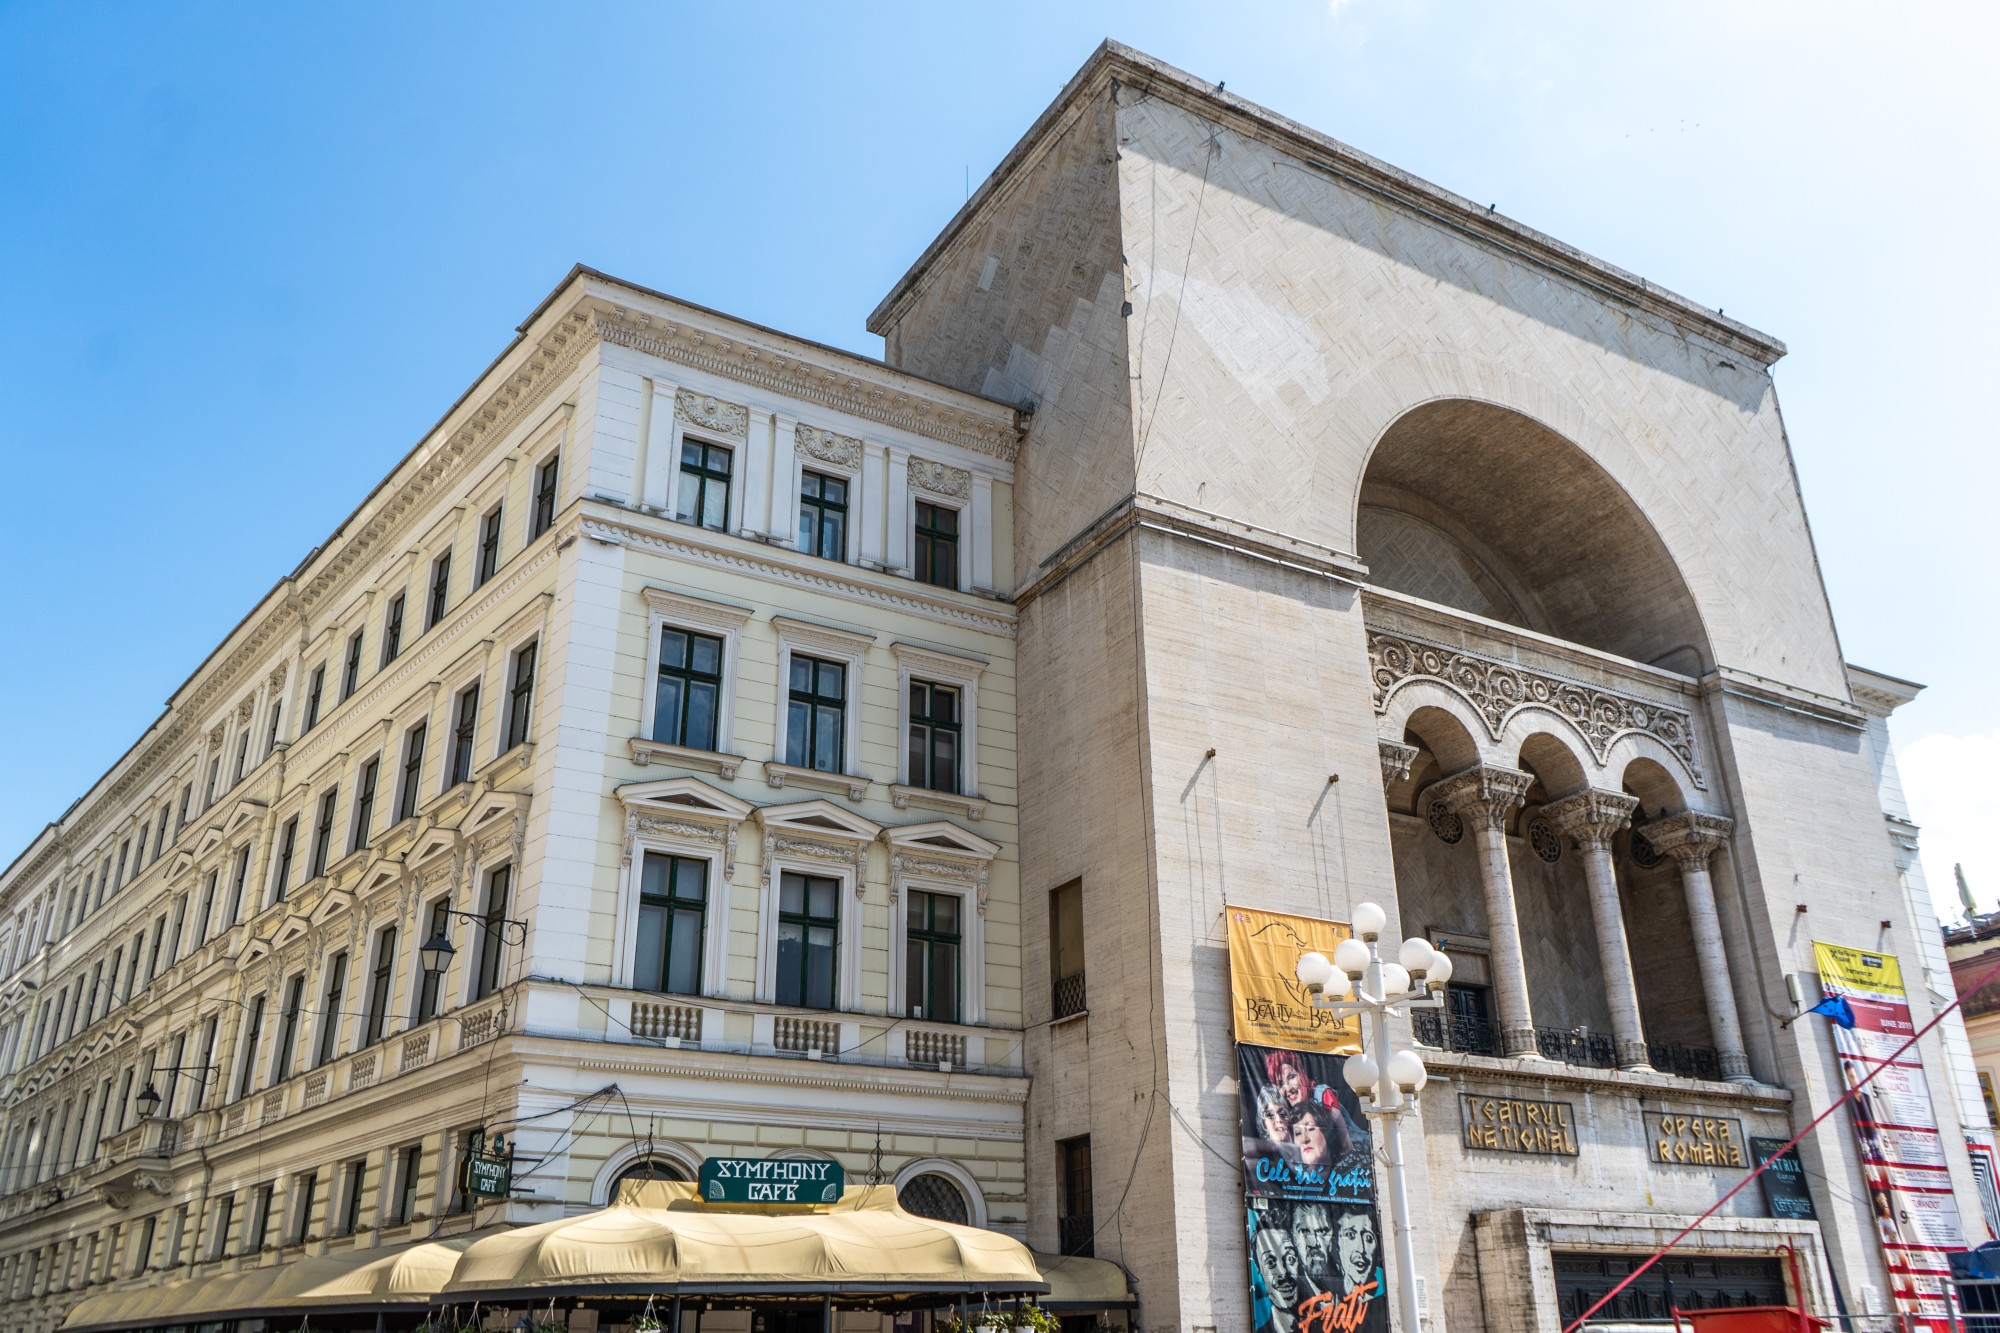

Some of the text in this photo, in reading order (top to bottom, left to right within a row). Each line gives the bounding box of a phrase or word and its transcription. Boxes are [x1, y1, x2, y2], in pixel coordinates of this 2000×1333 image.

[1898, 1021, 1912, 1030] 2019
[1872, 1085, 1879, 1099] 5
[1466, 1097, 1569, 1128] TEATRUL
[1661, 1116, 1731, 1140] OPERA
[1658, 1139, 1741, 1165] ROMANA
[474, 1161, 507, 1179] SYMPHONY
[716, 1160, 831, 1181] SYMPHONY
[1256, 1157, 1291, 1182] Cele
[1295, 1163, 1325, 1185] trei
[1760, 1156, 1801, 1172] MATRIX
[480, 1176, 496, 1193] CAFÉ
[748, 1180, 799, 1201] CAFÉ
